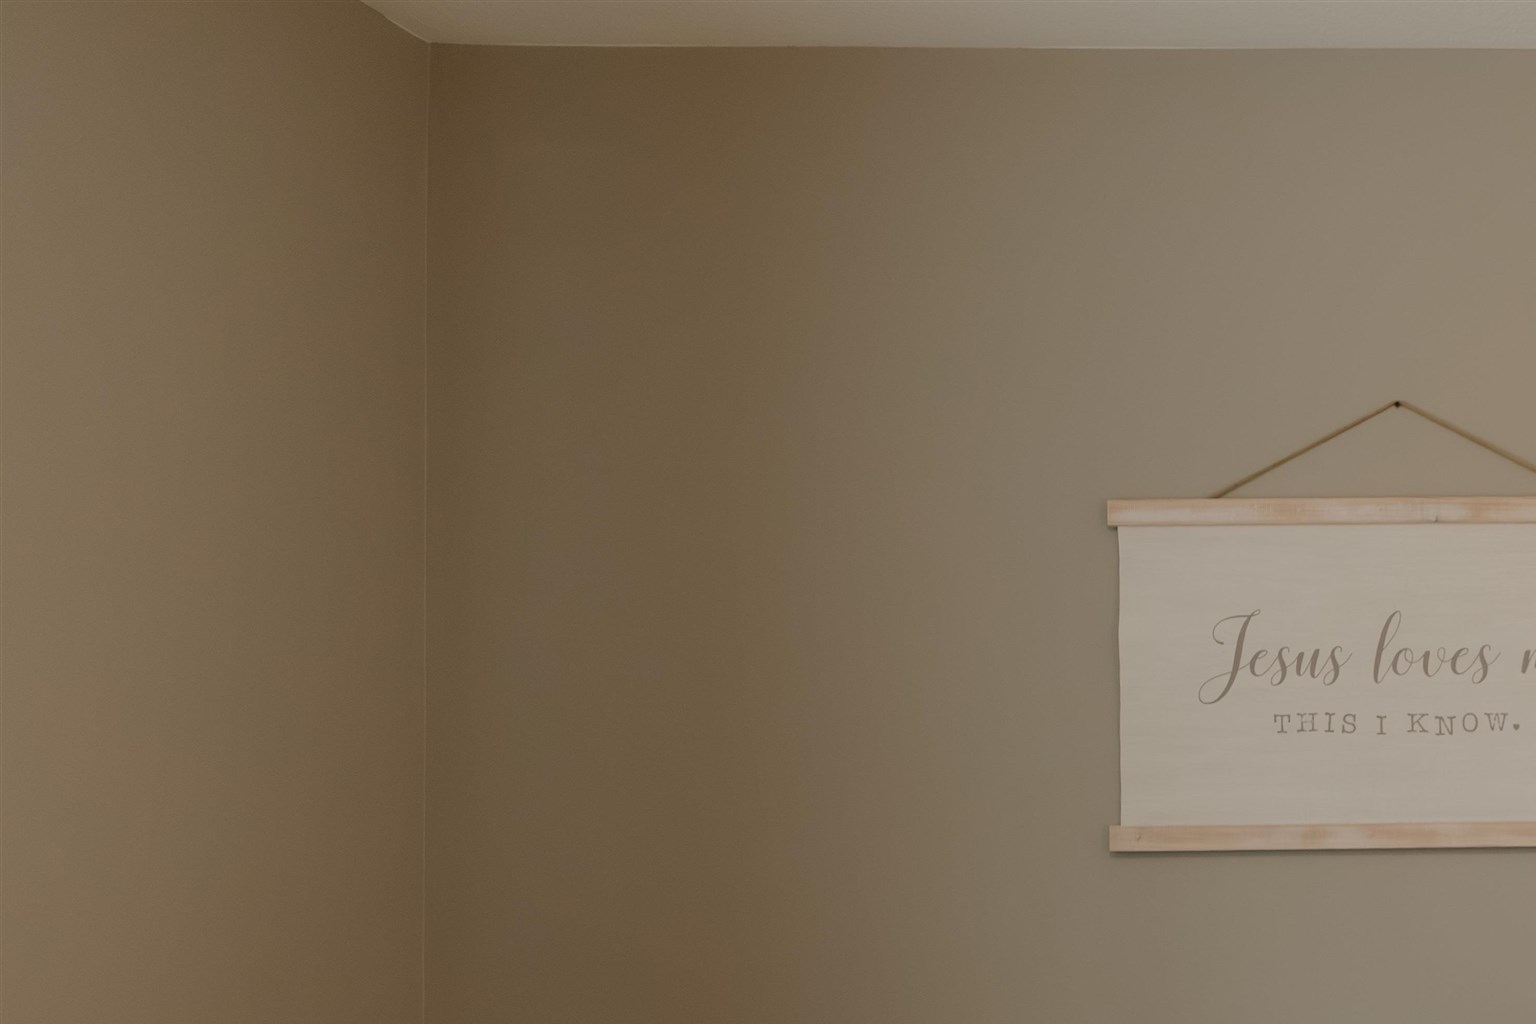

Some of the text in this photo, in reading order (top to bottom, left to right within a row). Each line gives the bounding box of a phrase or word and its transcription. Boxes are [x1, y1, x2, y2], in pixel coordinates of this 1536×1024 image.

[1198, 608, 1353, 705] Jesus
[1372, 609, 1501, 685] loves
[1273, 711, 1358, 735] THIS
[1375, 715, 1388, 736] I
